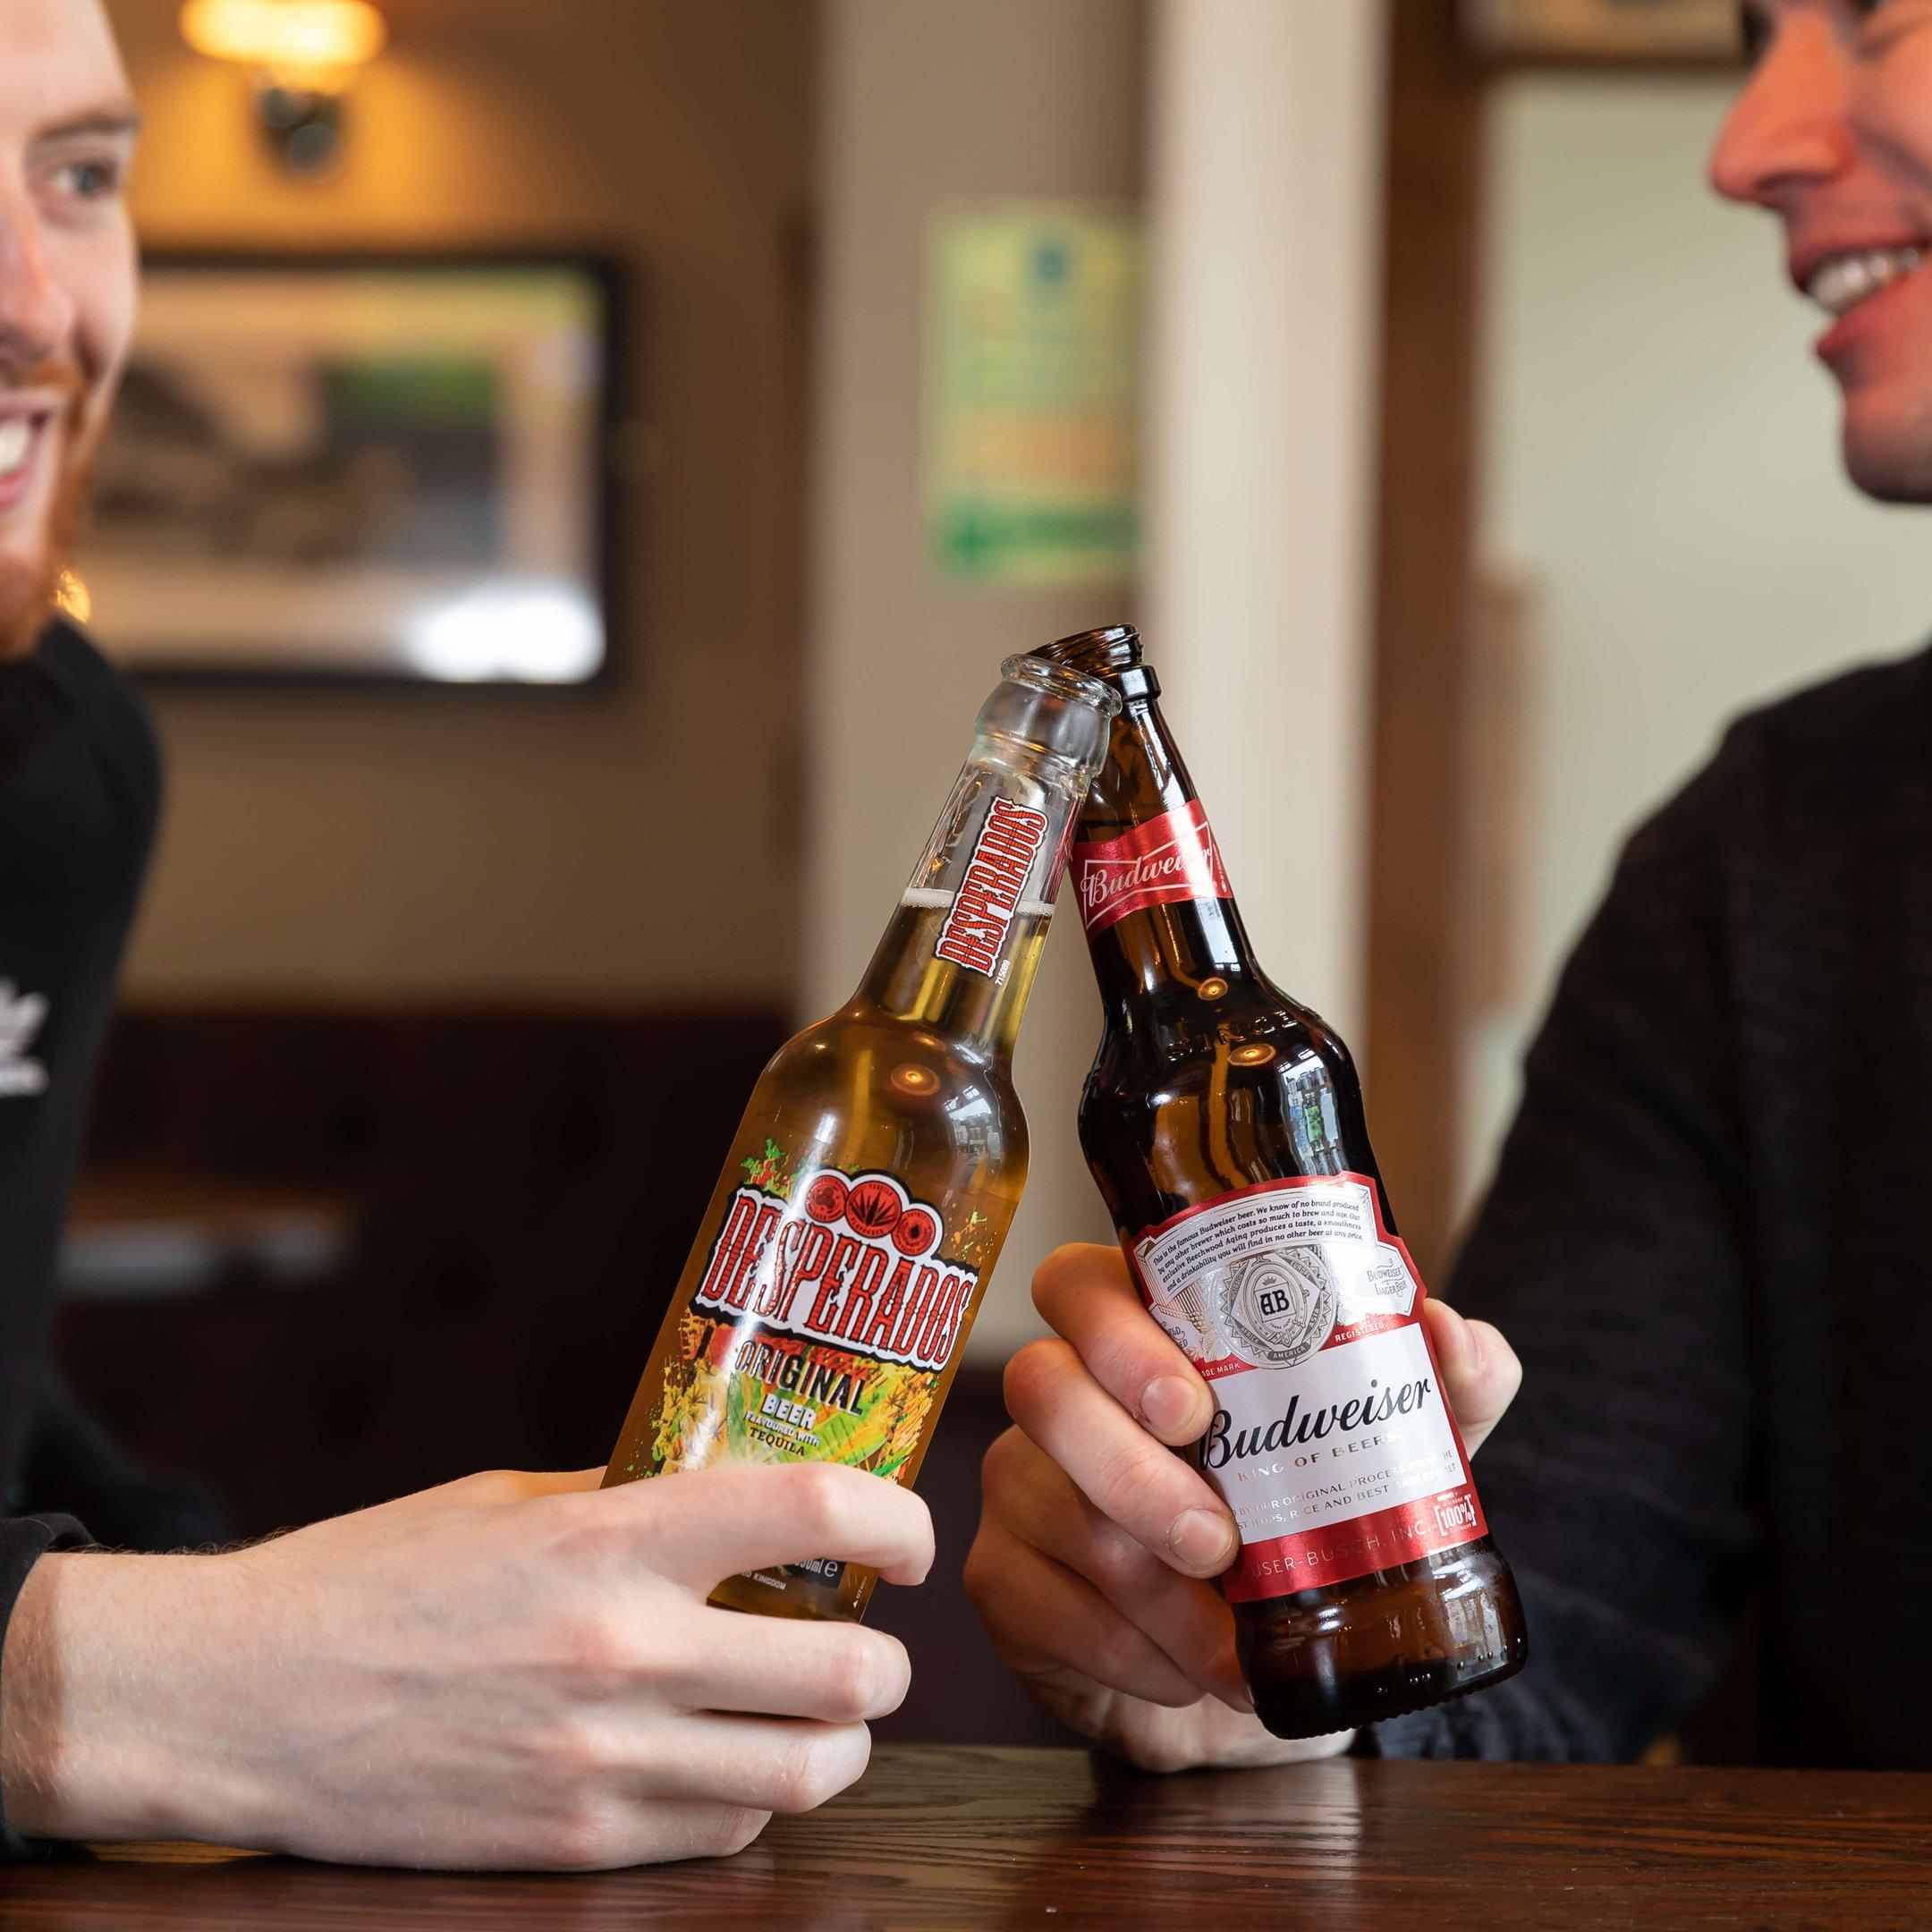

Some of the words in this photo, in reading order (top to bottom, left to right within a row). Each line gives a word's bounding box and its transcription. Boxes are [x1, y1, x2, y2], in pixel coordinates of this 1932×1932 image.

[937, 797, 1047, 975] DESPERADOS
[1080, 847, 1214, 909] Budweir
[1153, 1257, 1163, 1266] This
[1167, 1244, 1177, 1252] the
[1177, 1233, 1199, 1249] famous
[1199, 1216, 1236, 1234] Budweiser
[1238, 1211, 1256, 1220] beer.
[1257, 1207, 1267, 1215] We
[1270, 1203, 1290, 1212] know
[1292, 1201, 1300, 1209] of
[1333, 1202, 1359, 1211] produced
[1157, 1267, 1165, 1275] by
[1165, 1258, 1175, 1269] any
[1175, 1247, 1192, 1260] other
[1191, 1236, 1213, 1250] brewer
[1215, 1226, 1235, 1239] which
[1238, 1219, 1256, 1230] costs
[1270, 1211, 1290, 1221] much
[1163, 1261, 1185, 1283] exclusive
[1187, 1241, 1224, 1264] Beechwood
[1225, 1233, 1248, 1247] Aging
[1250, 1221, 1286, 1237] produces
[1324, 1220, 1361, 1230] smoothness
[699, 1193, 978, 1366] DESPERADOS
[1167, 1279, 1177, 1292] and
[1181, 1255, 1216, 1279] drinkability
[1217, 1250, 1231, 1259] you
[1233, 1242, 1246, 1252] will
[1247, 1237, 1263, 1250] find
[1287, 1231, 1306, 1239] other
[1348, 1232, 1363, 1241] price.
[1241, 1326, 1258, 1343] AFRICA
[1309, 1308, 1320, 1327] ASIA
[1201, 1368, 1215, 1377] ADE
[1217, 1362, 1241, 1373] MARK
[1273, 1346, 1306, 1359] AMERICA
[735, 1340, 866, 1417] ORIGINAL
[762, 1394, 817, 1430] BEER
[1197, 1375, 1431, 1471] Budweiser
[750, 1427, 805, 1456] TEQUILA
[1238, 1462, 1284, 1481] KING
[1294, 1453, 1320, 1467] OF
[1283, 1484, 1345, 1505] ORIGINAL
[1290, 1504, 1319, 1520] RCE
[1325, 1496, 1352, 1511] AND
[1357, 1485, 1389, 1501] BEST
[1391, 1521, 1431, 1543] INC.
